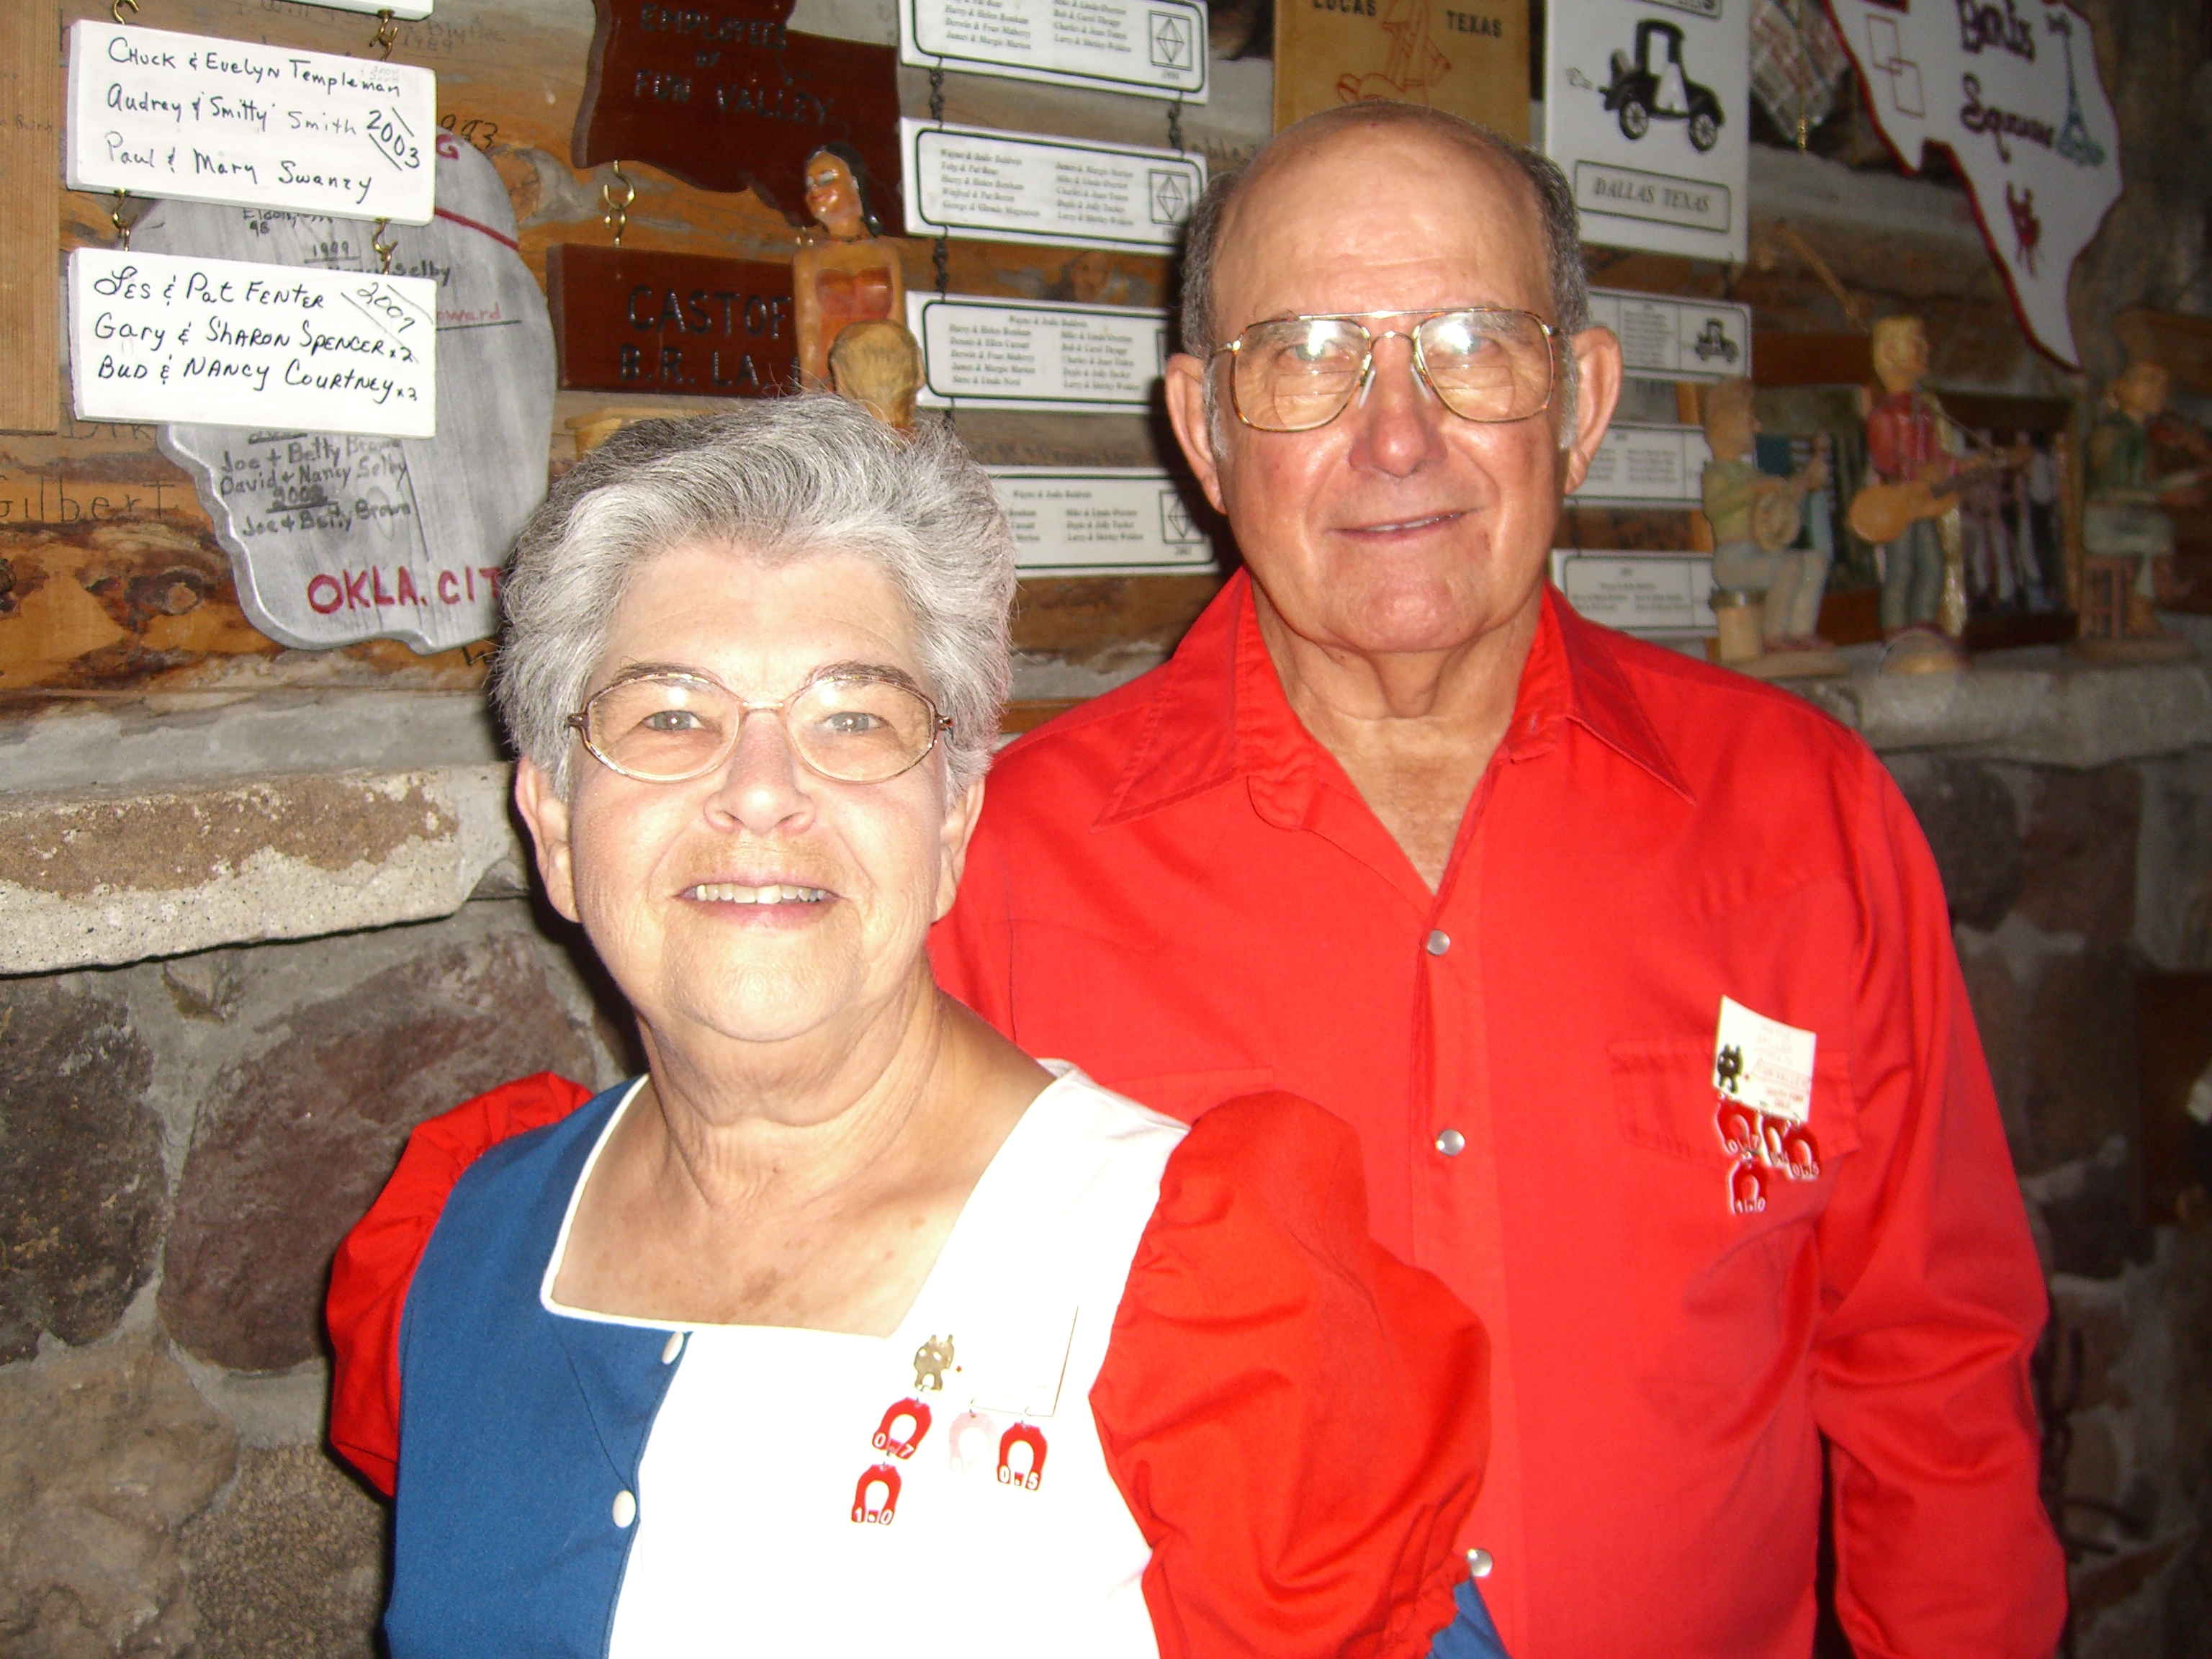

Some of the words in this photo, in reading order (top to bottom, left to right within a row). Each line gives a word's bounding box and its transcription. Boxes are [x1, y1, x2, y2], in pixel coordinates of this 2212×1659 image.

[640, 2, 787, 50] EMPLOYEES
[1445, 9, 1502, 37] TEXAS
[289, 59, 400, 97] Templeman
[107, 84, 182, 122] Audrey
[288, 110, 356, 137] Smith
[634, 69, 691, 102] FUN
[717, 84, 835, 126] VALLEY
[104, 130, 155, 168] Paul
[193, 148, 258, 185] Mary
[367, 109, 421, 169] 2003
[1593, 176, 1655, 204] DALLAS
[1663, 187, 1710, 212] TEXAS
[186, 272, 235, 304] Pat
[435, 302, 502, 322] oward
[629, 285, 792, 339] CASTOF
[95, 313, 165, 351] Gary
[221, 449, 261, 473] Joe
[288, 435, 341, 469] Betty
[220, 468, 278, 498] David
[298, 463, 353, 489] Nancy
[307, 565, 429, 615] OKLA.
[438, 565, 503, 606] CIT
